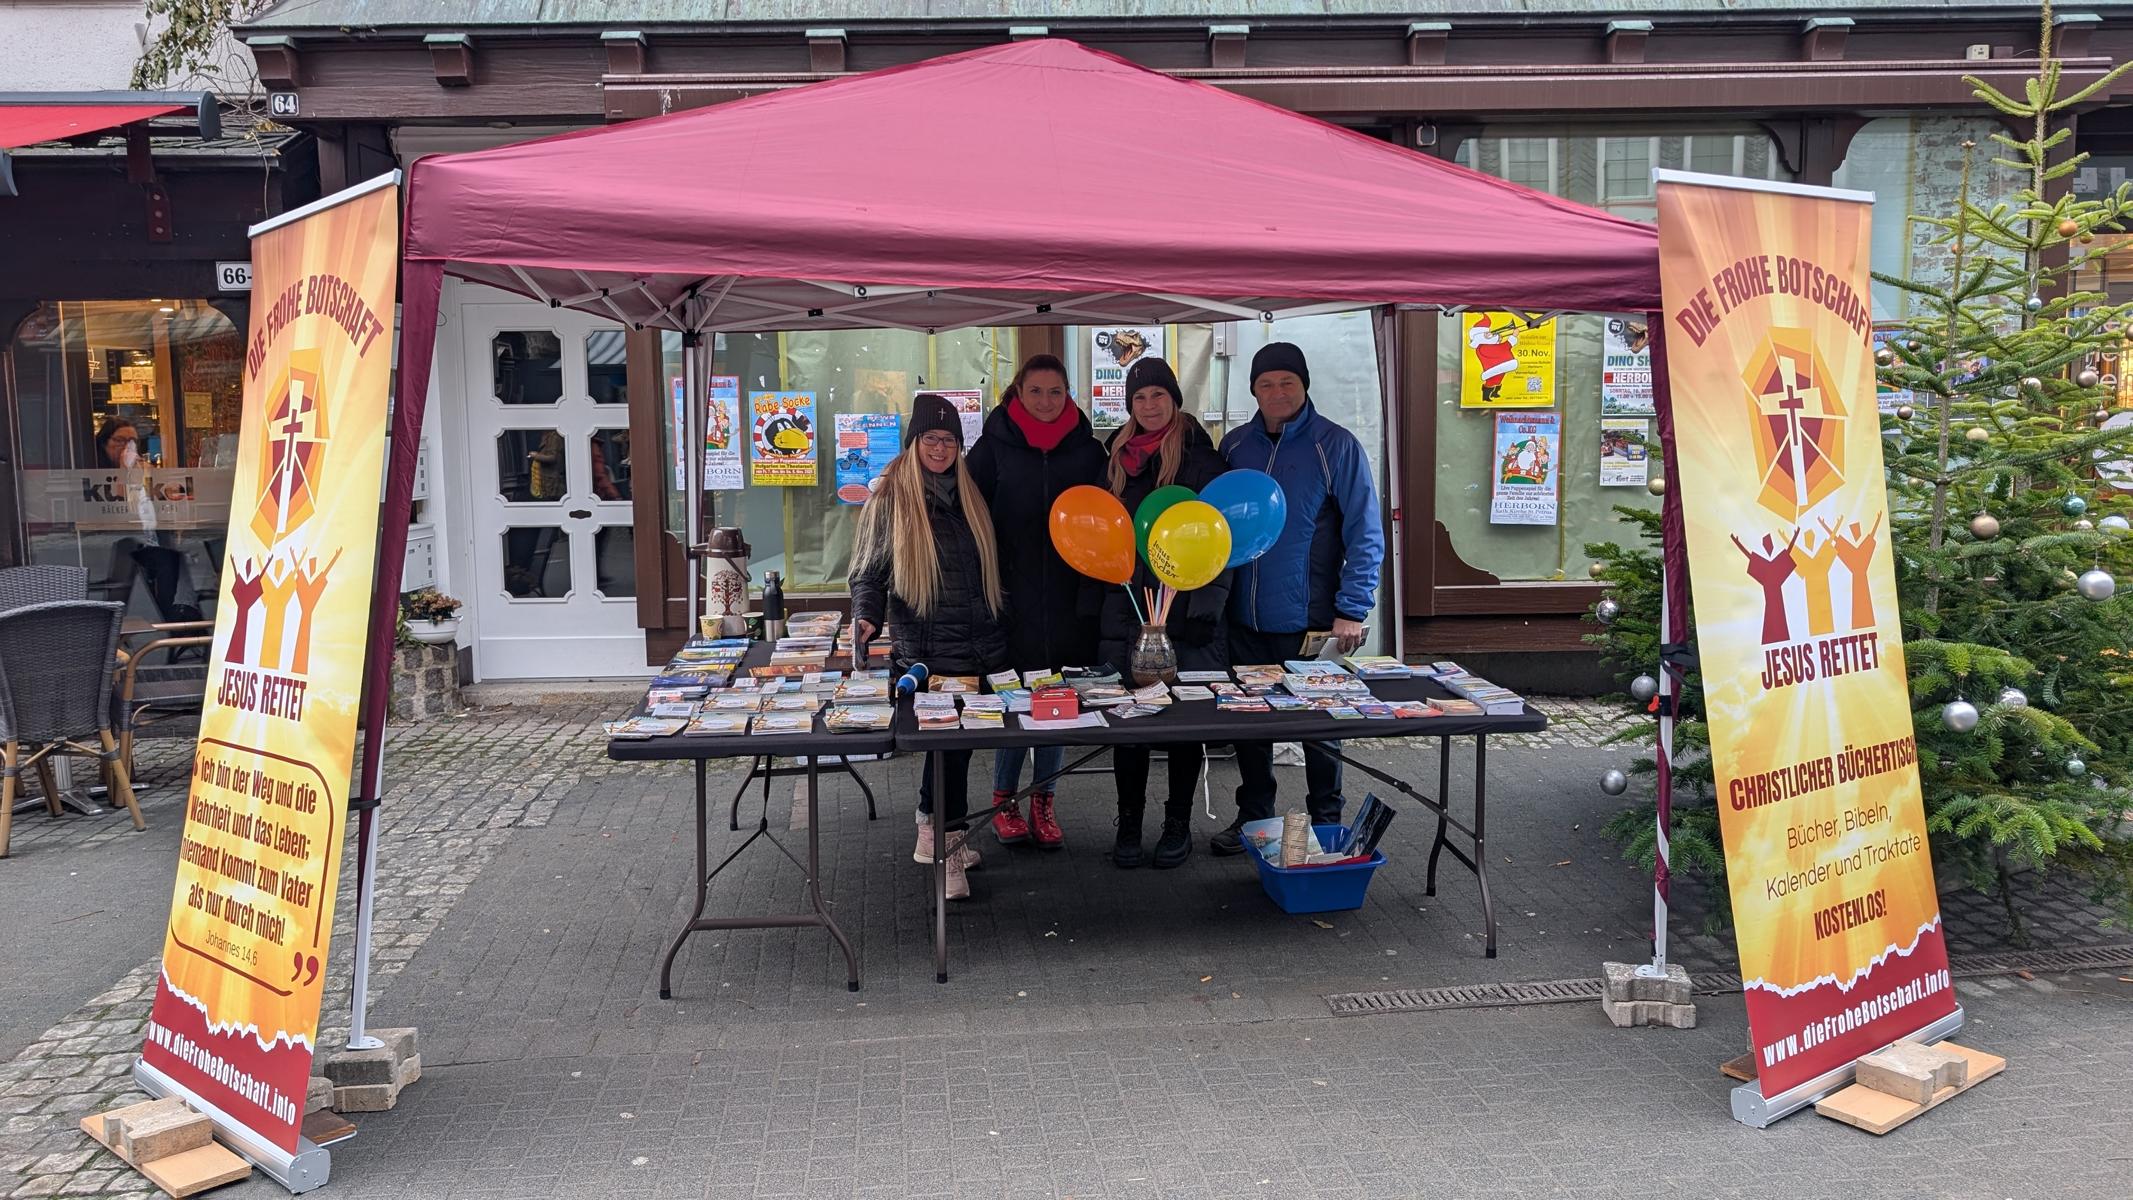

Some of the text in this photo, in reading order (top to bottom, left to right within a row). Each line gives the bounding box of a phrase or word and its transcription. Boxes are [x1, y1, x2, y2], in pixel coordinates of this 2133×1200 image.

[274, 95, 296, 114] 64
[249, 273, 385, 383] DIE FROHE BOTSCHAFT
[1675, 255, 1872, 348] DIE FROHE BOTSCHAFT
[1095, 368, 1122, 380] DINO
[1531, 349, 1551, 357] Nov.
[1607, 355, 1634, 366] DINO
[1613, 372, 1652, 384] HERBO
[754, 401, 779, 413] Rabe
[782, 396, 810, 409] Socke
[81, 476, 195, 502] kükel
[1494, 502, 1555, 510] HERBORN
[1761, 632, 1879, 690] JESUS RETTET
[217, 667, 307, 722] JESUS RETTET
[201, 756, 317, 814] Ich bin der Weg und die
[1729, 756, 1835, 811] CHRISTLICHER
[190, 794, 311, 860] Wahrheit und das Leben;
[1787, 801, 1893, 850] Bücher, Bibeln,
[220, 848, 257, 887] kommt
[257, 865, 279, 896] zum
[280, 870, 314, 908] Vater
[1766, 833, 1922, 901] Kalender und Traktate
[188, 882, 286, 946] als nur durch mich!
[1814, 889, 1887, 941] KOSTENLOS!
[205, 929, 258, 966] Johannes 14,6
[1762, 969, 1950, 1067] www.dieFroheBotschaft.info
[148, 1020, 297, 1126] www.dieFroheBotschaft.info
